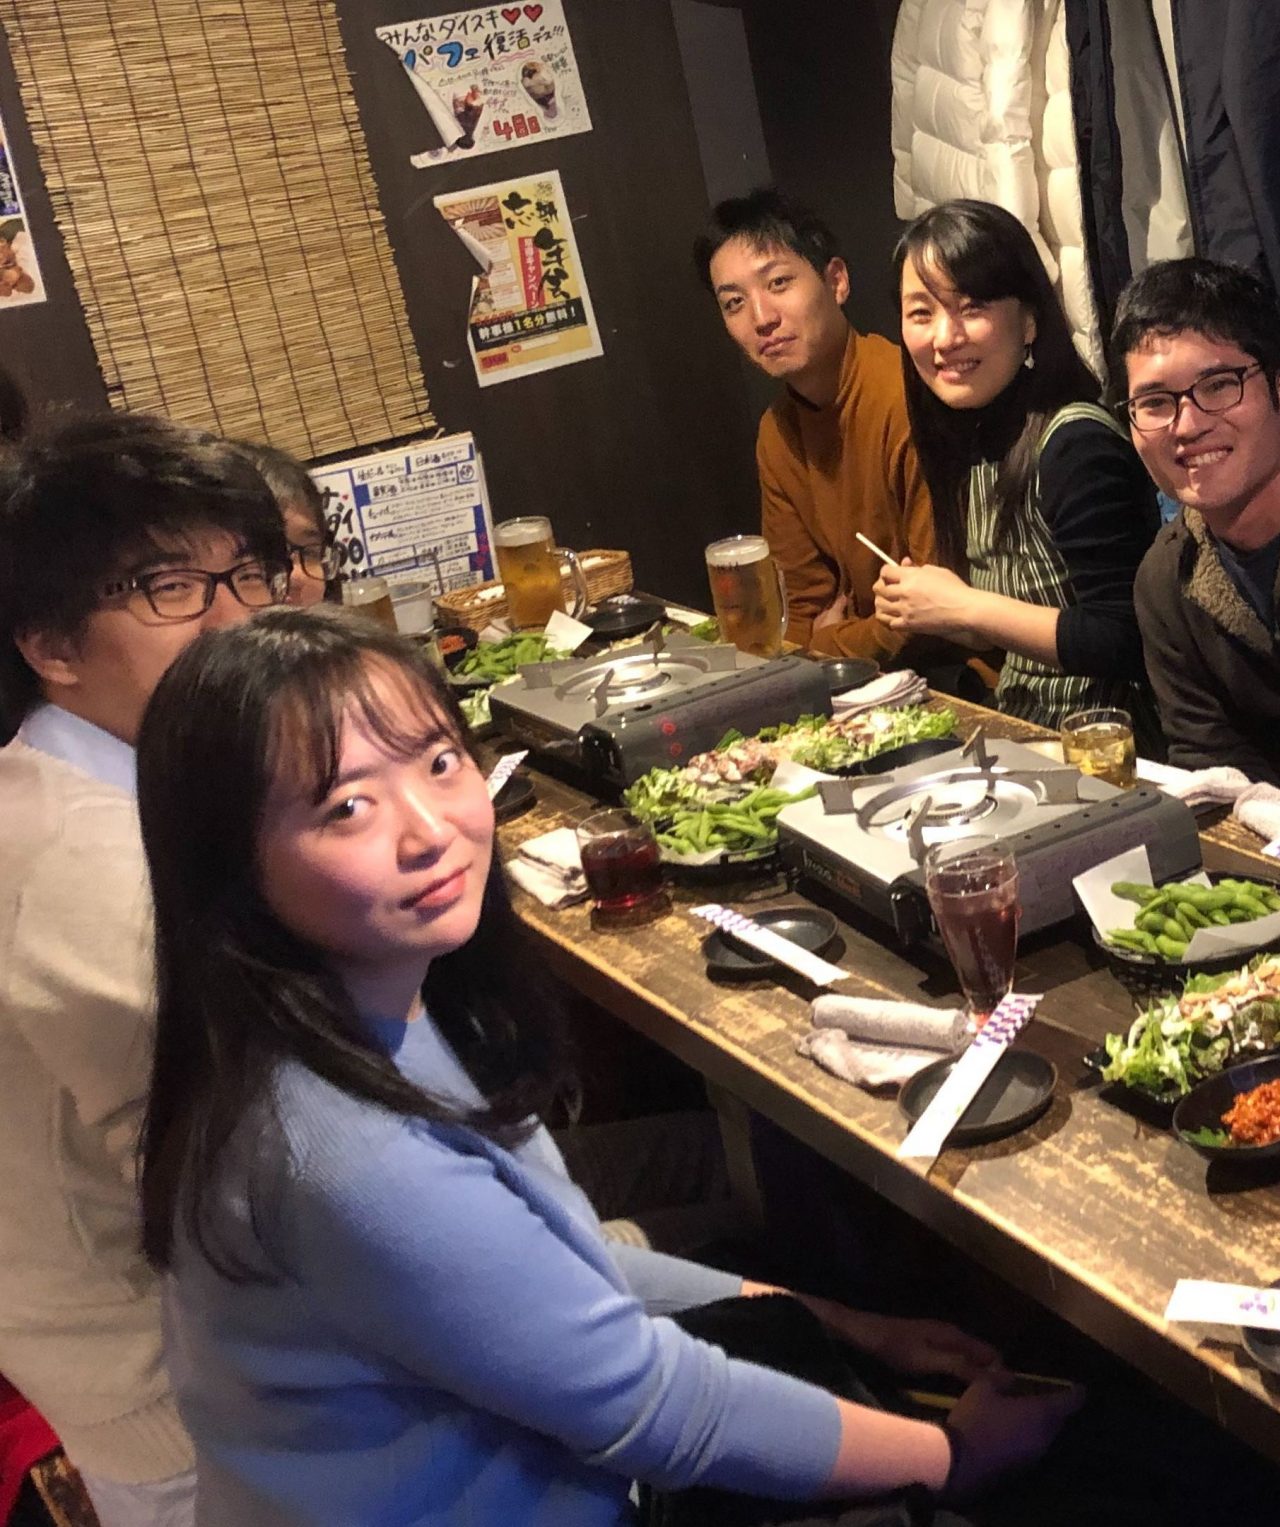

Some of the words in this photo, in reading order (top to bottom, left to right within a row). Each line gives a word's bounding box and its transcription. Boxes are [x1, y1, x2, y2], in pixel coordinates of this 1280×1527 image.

[382, 10, 498, 46] みんなダイスキ
